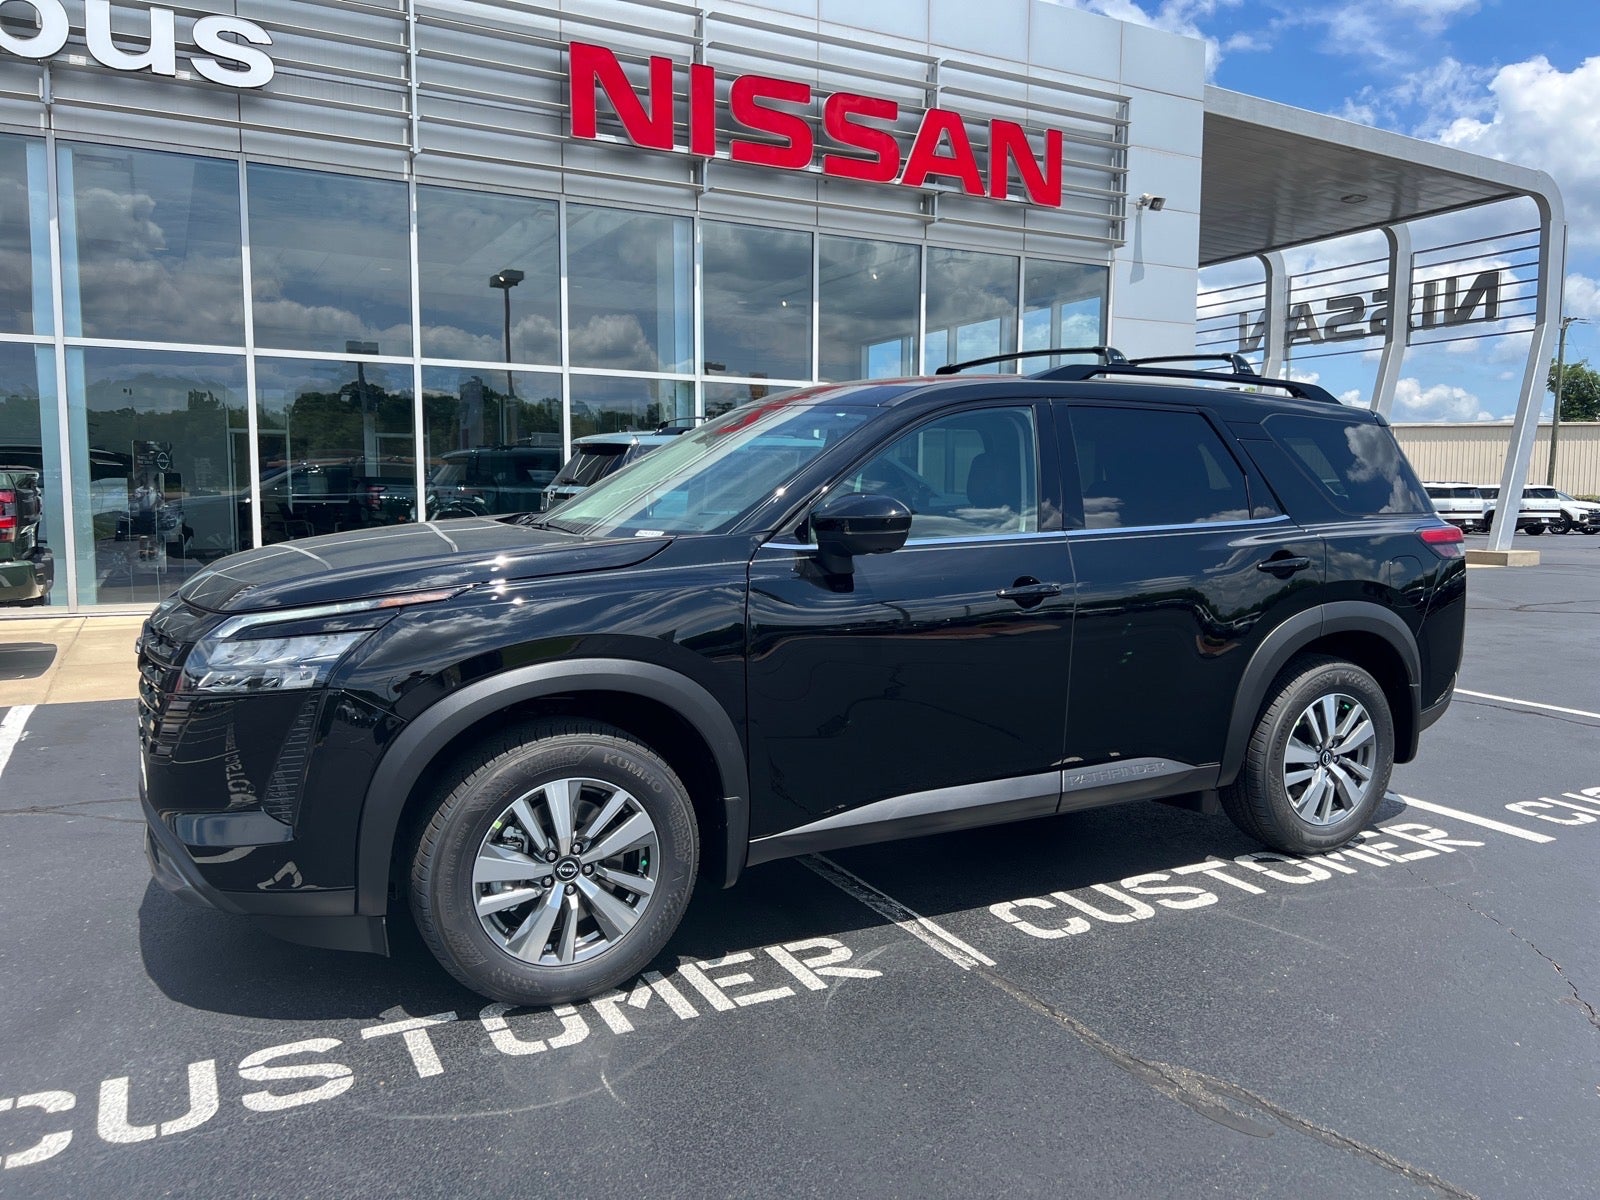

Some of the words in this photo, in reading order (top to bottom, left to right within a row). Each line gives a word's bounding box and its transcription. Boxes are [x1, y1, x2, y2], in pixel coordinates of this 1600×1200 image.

[569, 41, 1063, 208] NISSAN
[603, 753, 663, 793] KUMHO
[1069, 762, 1166, 785] PATHFINDER
